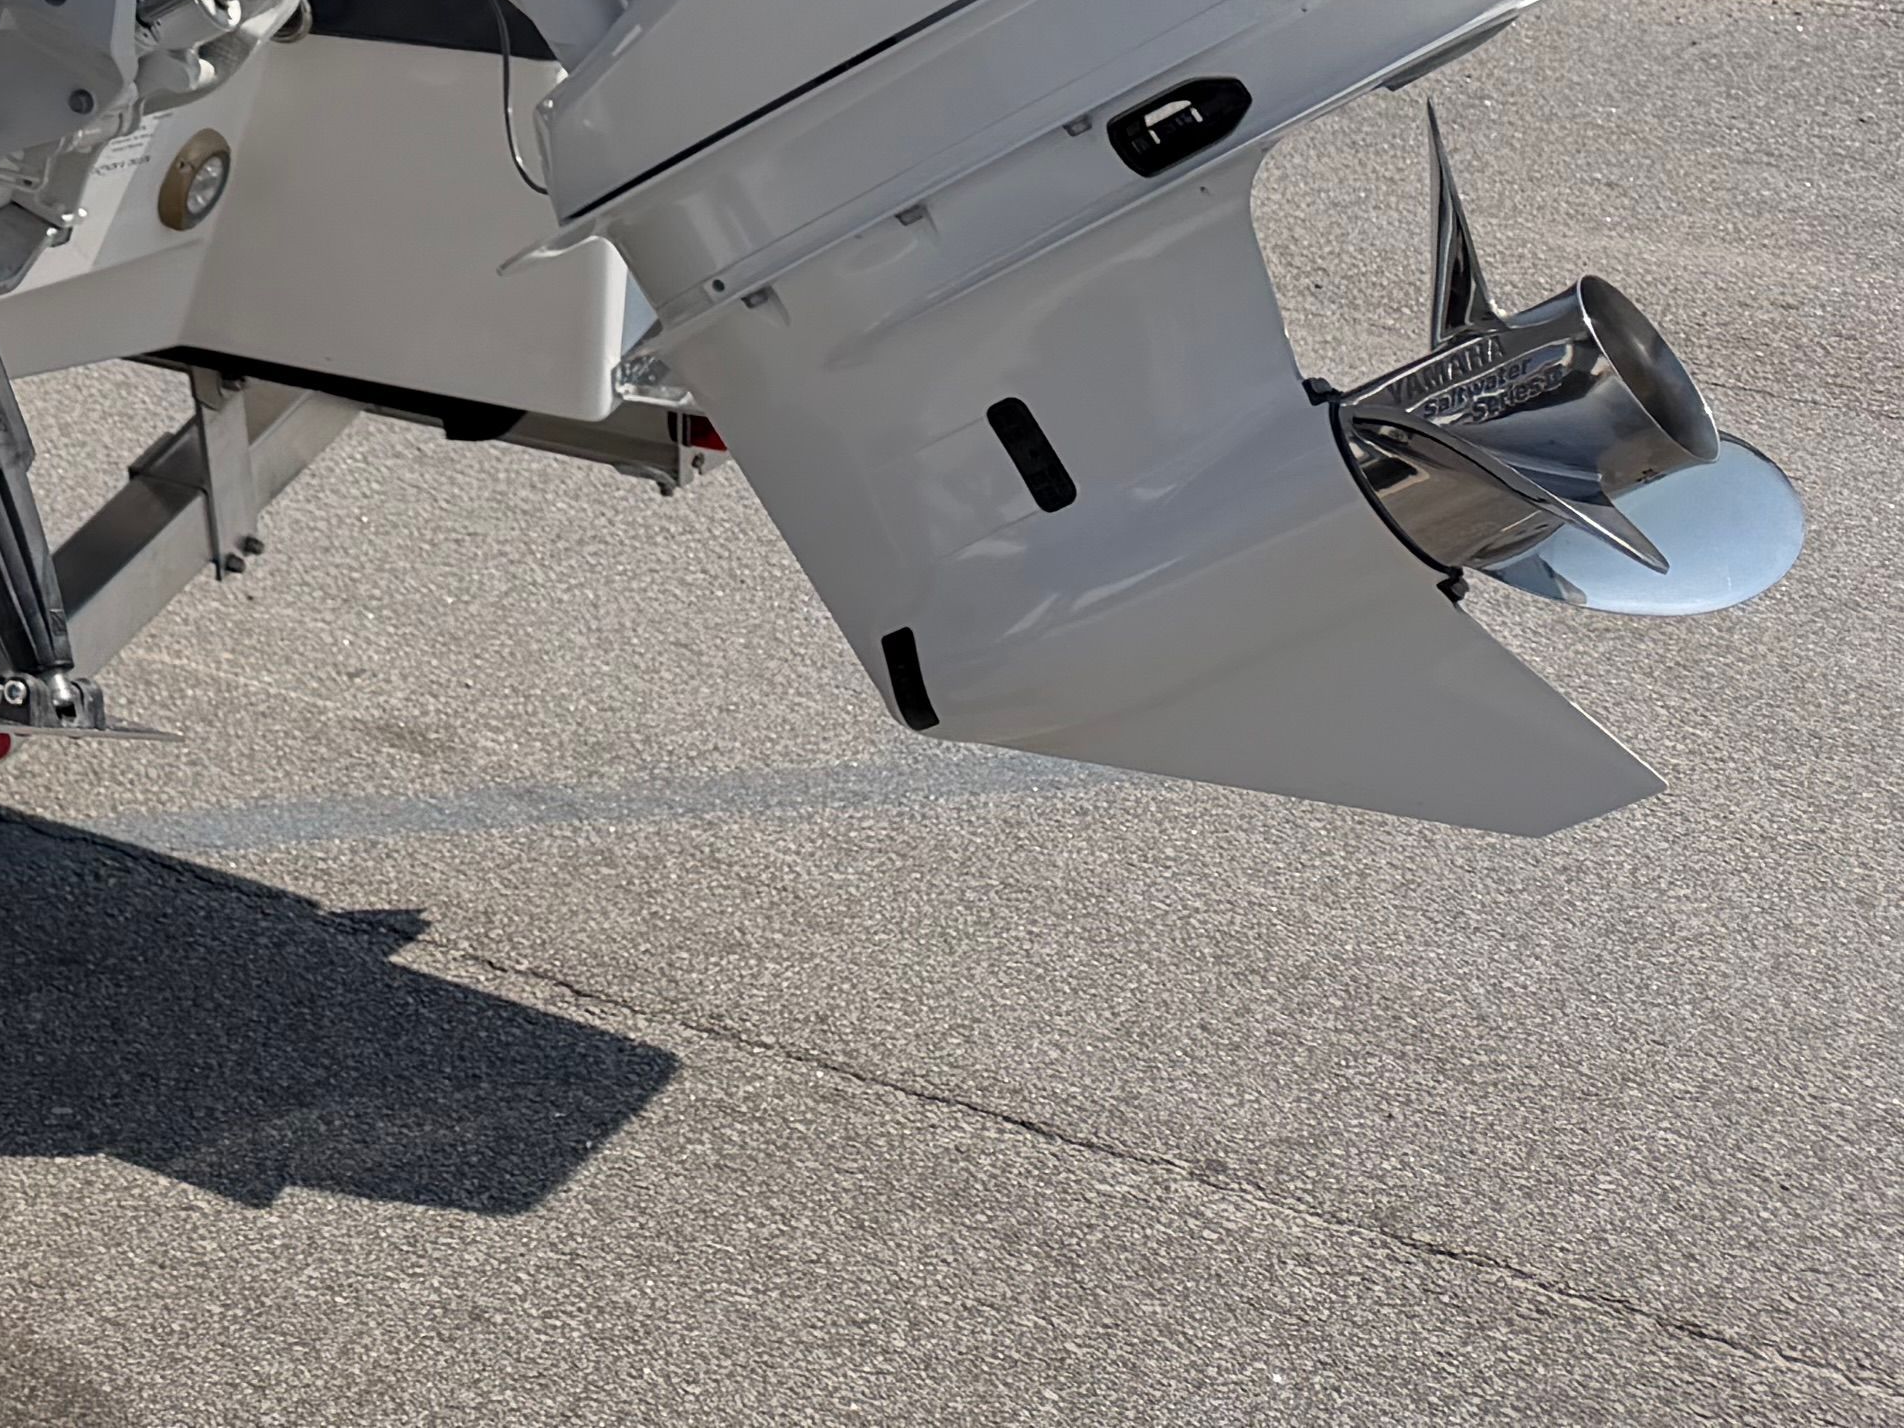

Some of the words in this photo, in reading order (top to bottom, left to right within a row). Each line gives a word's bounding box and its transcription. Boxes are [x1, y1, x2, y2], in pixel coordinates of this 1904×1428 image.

[1388, 335, 1505, 403] YAMAHA
[1423, 357, 1532, 418] Saltwater
[1471, 372, 1544, 422] Series
